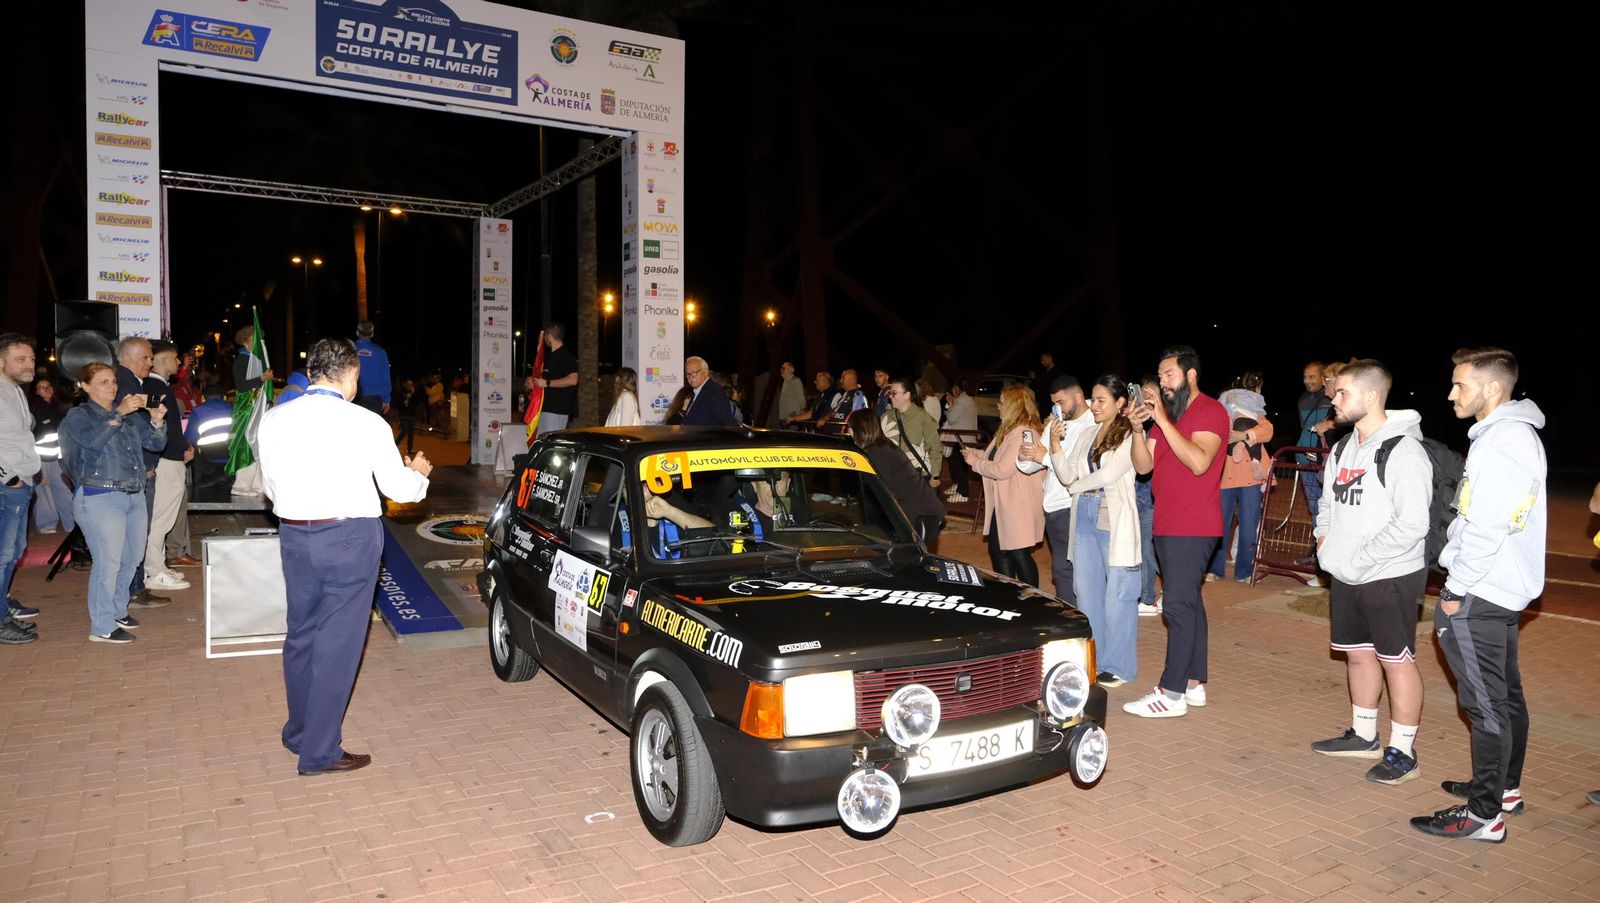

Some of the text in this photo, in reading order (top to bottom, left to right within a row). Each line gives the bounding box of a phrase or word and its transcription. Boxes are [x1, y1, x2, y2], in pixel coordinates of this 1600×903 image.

[191, 20, 255, 41] CERA
[204, 40, 244, 55] Recalvi
[336, 18, 501, 64] 50 RALLYE
[336, 42, 499, 78] COSTA DE ALMERÍA
[111, 78, 148, 87] MICHELIN
[551, 87, 591, 100] COSTA DE
[543, 96, 592, 112] ALMERÍA
[620, 99, 671, 114] DIPUTACIÓN
[98, 111, 149, 127] Rallycar
[620, 108, 669, 123] DE ALMERÍA
[112, 158, 149, 166] MICHELIN
[99, 192, 150, 205] Rallycar
[99, 271, 150, 283] Rallycar
[643, 265, 679, 275] gasolia
[644, 304, 679, 316] Phonika
[690, 455, 836, 466] AUTOMÓVIL CLUB DE ALMERÍA
[539, 470, 559, 488] SÁNCHEZ
[536, 485, 556, 503] SÁNCHEZ
[1349, 488, 1363, 505] IT
[589, 573, 608, 608] 67
[881, 597, 1022, 620] motor
[641, 599, 744, 669] ALMERICARNE.COM
[919, 726, 1025, 770] S 7488 K
